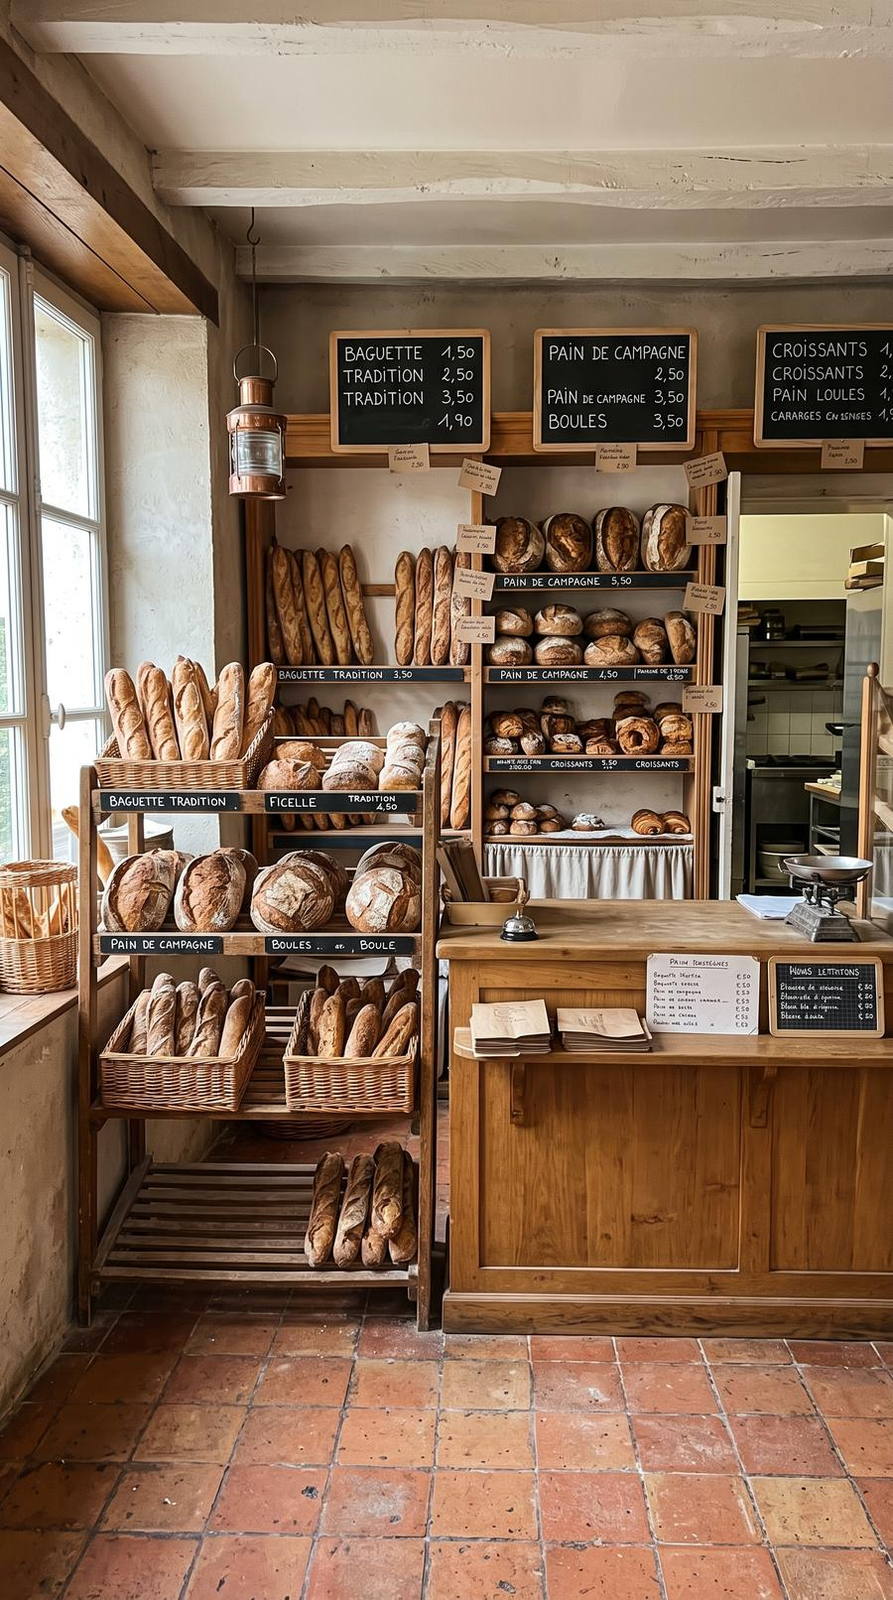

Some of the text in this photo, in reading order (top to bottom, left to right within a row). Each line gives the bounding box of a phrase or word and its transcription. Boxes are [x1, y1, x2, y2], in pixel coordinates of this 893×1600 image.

[345, 346, 475, 361] BAGUETTE 1,50
[549, 343, 686, 361] PAIN DE CAMPAGNE
[772, 339, 868, 358] CROISSANTS
[343, 366, 474, 383] TRADITION 2,50
[654, 367, 684, 382] 2,50
[772, 363, 864, 380] CROISSANTS
[343, 389, 474, 406] TRADITION 3,50
[548, 387, 684, 405] PAIN DE CAMPAGNE 3,50
[773, 385, 807, 402] PAIN
[817, 388, 865, 401] LOULES
[438, 414, 472, 430] 1,90
[549, 414, 683, 430] BOULES 3,50
[504, 577, 632, 586] PAIN DE CAMPAGNE 5,50
[279, 670, 325, 679] BAGUETTE
[333, 670, 383, 679] TRADITION
[500, 669, 521, 679] PAIN
[542, 671, 588, 679] CAMPAGNE
[110, 796, 226, 807] BAGUETTE TRADITION
[270, 797, 316, 808] FICELLE
[111, 938, 214, 949] PAIN DE CAMPAGNE
[272, 940, 396, 950] BOULES BOULE
